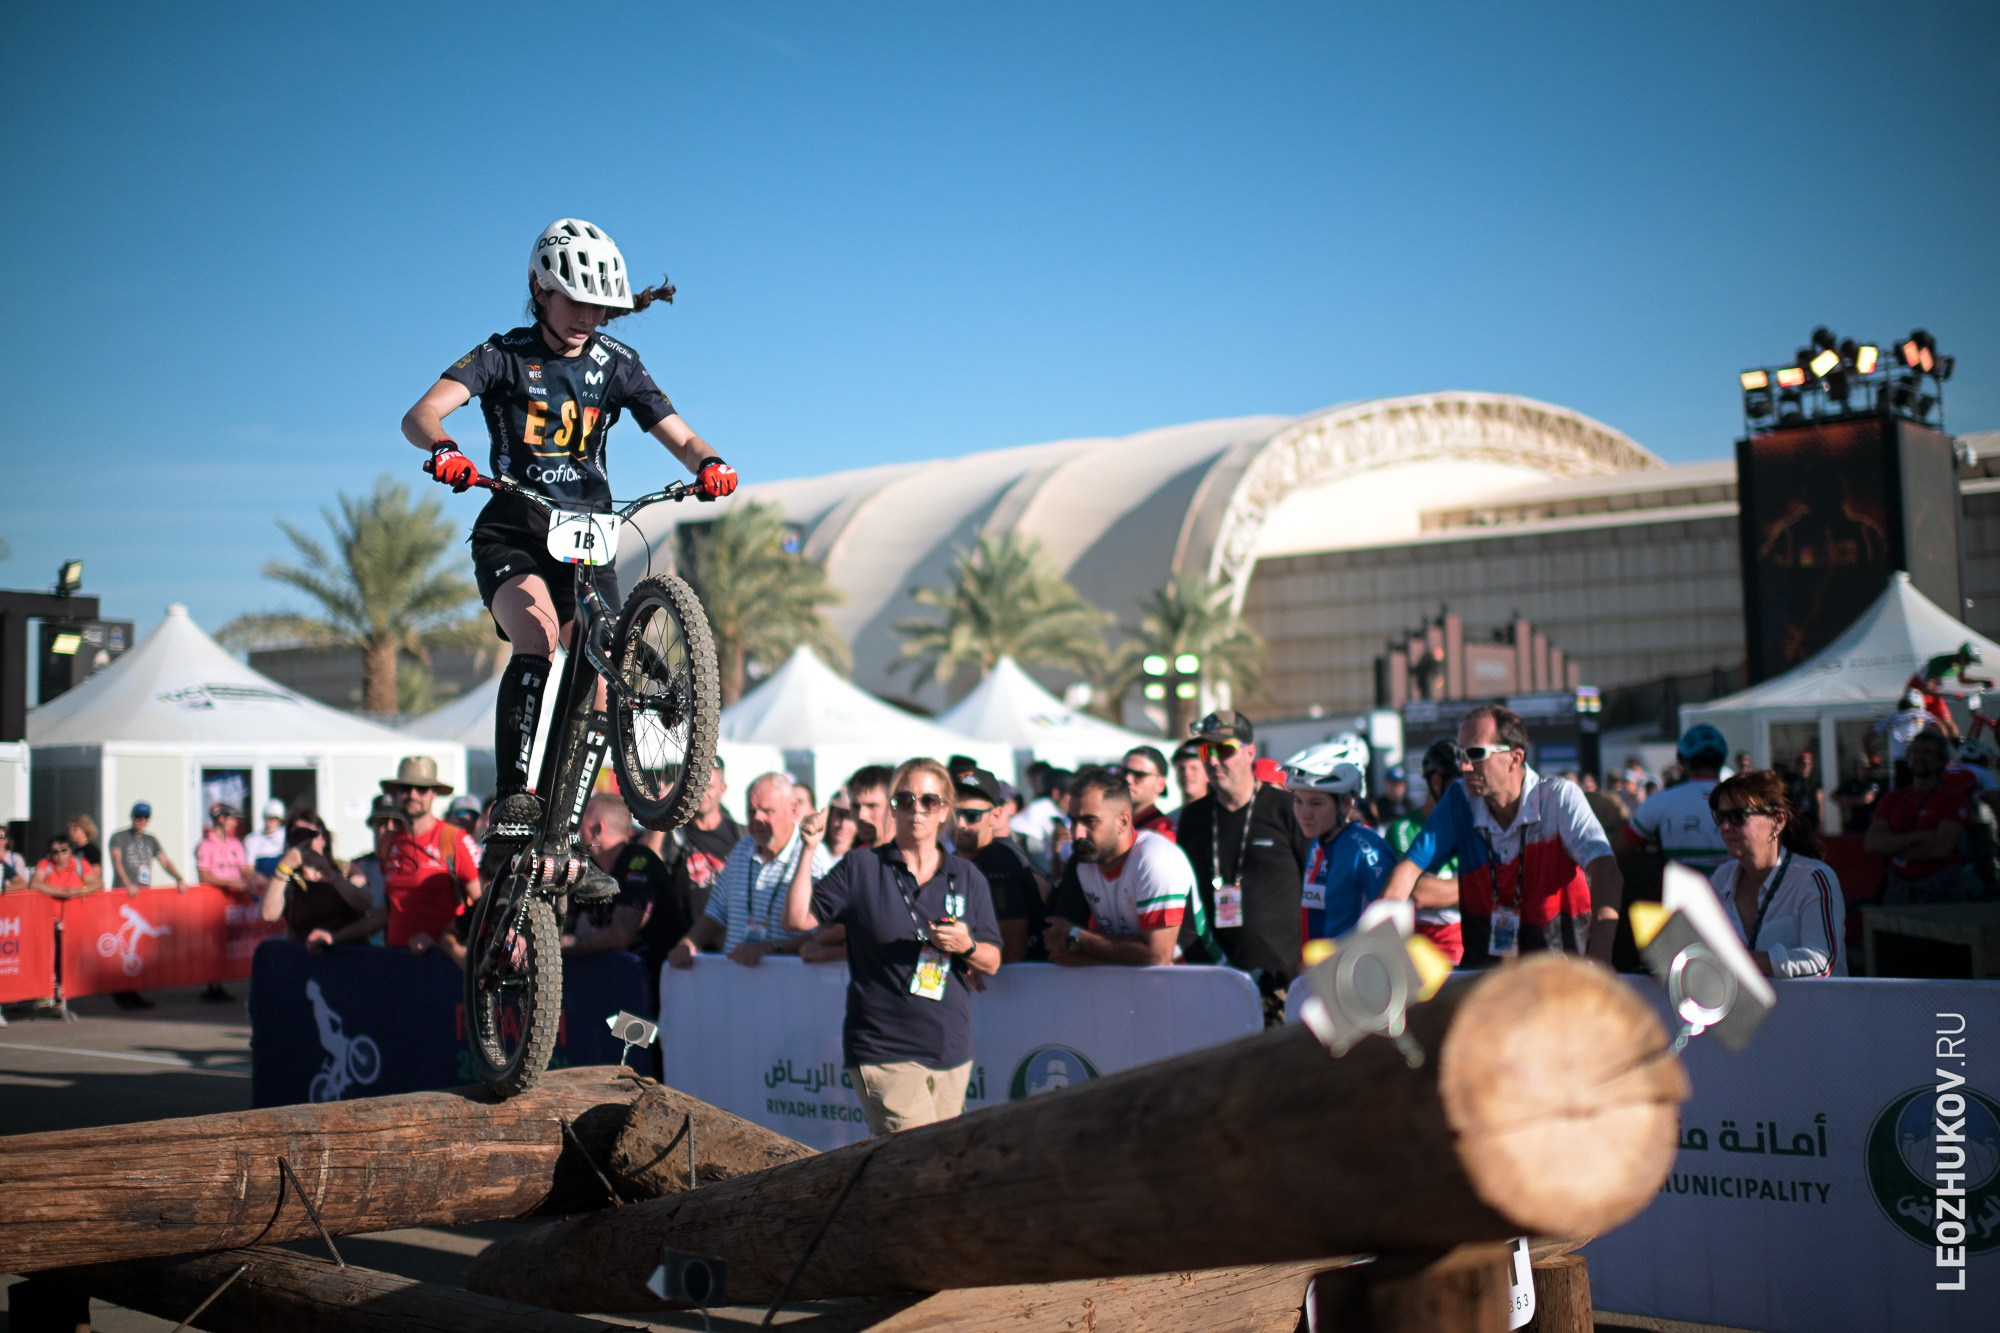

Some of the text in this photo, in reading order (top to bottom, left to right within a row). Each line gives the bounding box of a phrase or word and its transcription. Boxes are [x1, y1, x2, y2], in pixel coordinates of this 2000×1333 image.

[600, 335, 632, 360] Cofidis
[523, 400, 600, 451] ESP
[766, 1098, 866, 1123] RIYADH REGIO
[1719, 1112, 1828, 1157] أمانة
